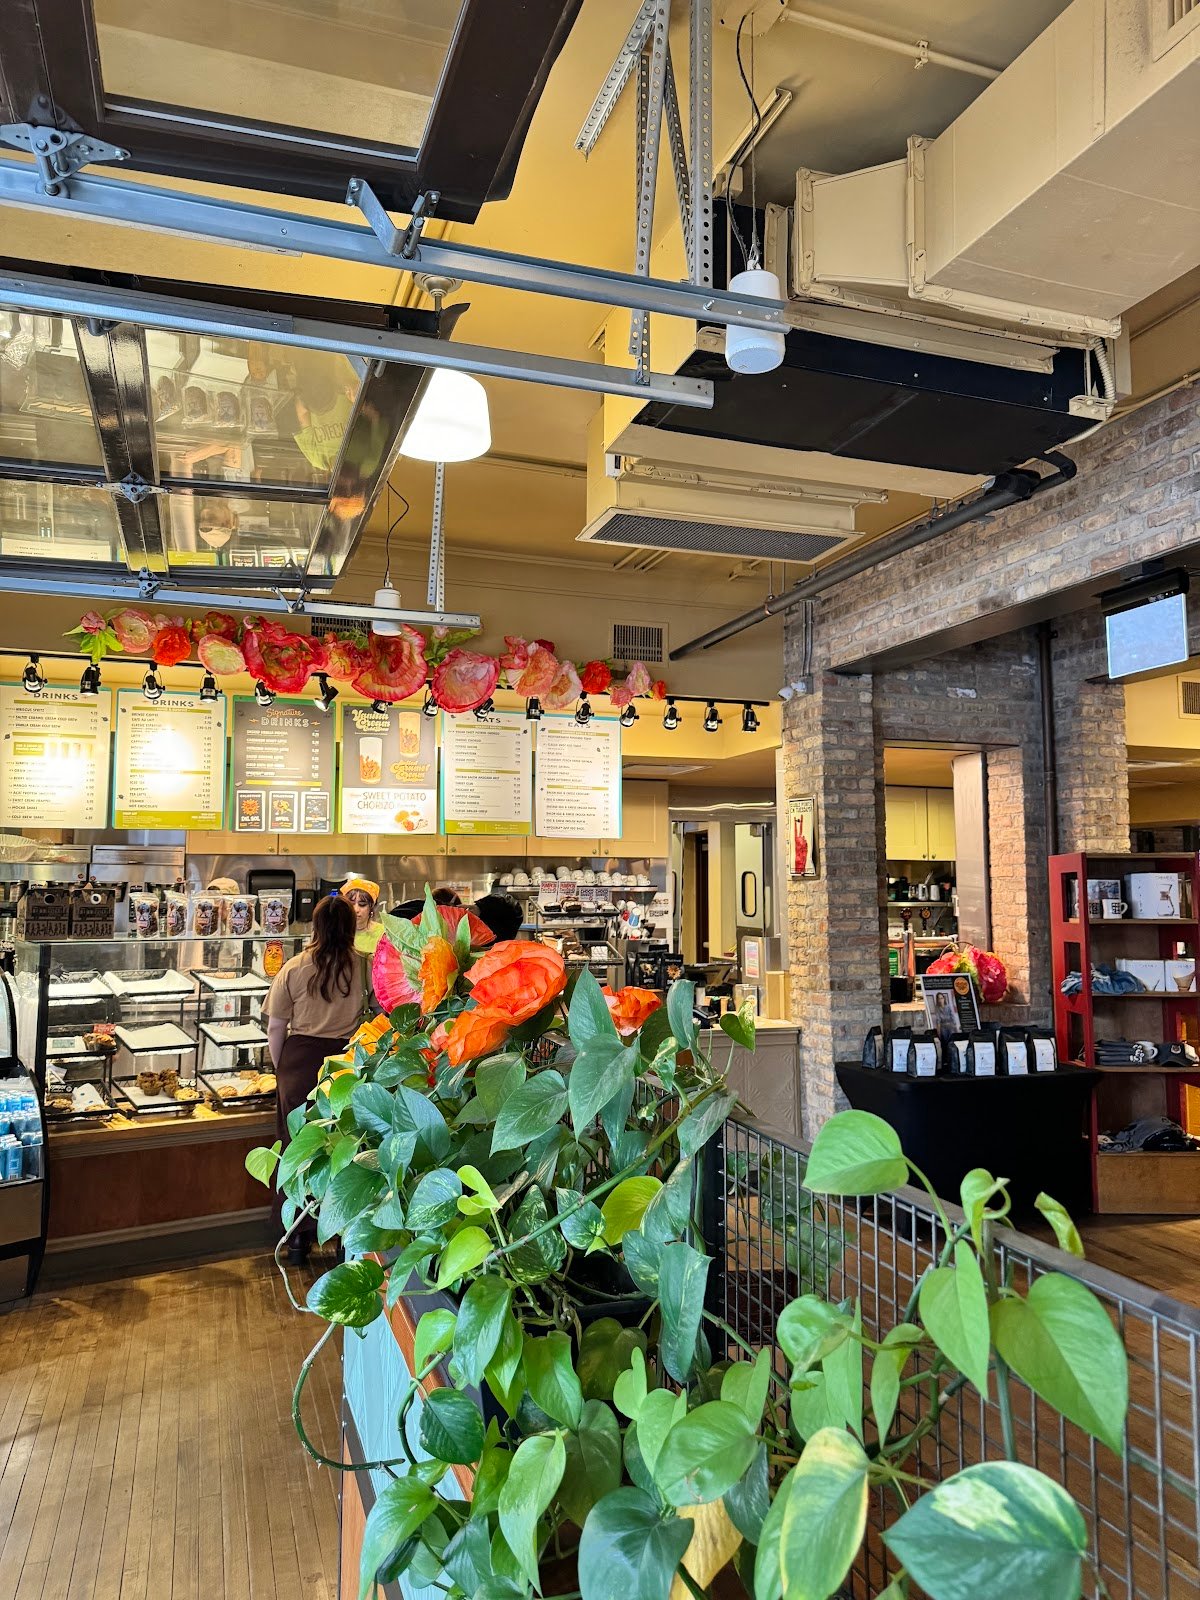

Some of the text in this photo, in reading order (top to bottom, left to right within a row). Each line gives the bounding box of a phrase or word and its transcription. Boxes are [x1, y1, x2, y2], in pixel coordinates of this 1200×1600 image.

[34, 692, 78, 700] DRINKS
[152, 700, 194, 708] DRINKS
[266, 708, 304, 718] Signature
[261, 717, 310, 728] DRINKS
[363, 792, 426, 801] SWEET POTATO
[357, 801, 394, 809] CHORIZO
